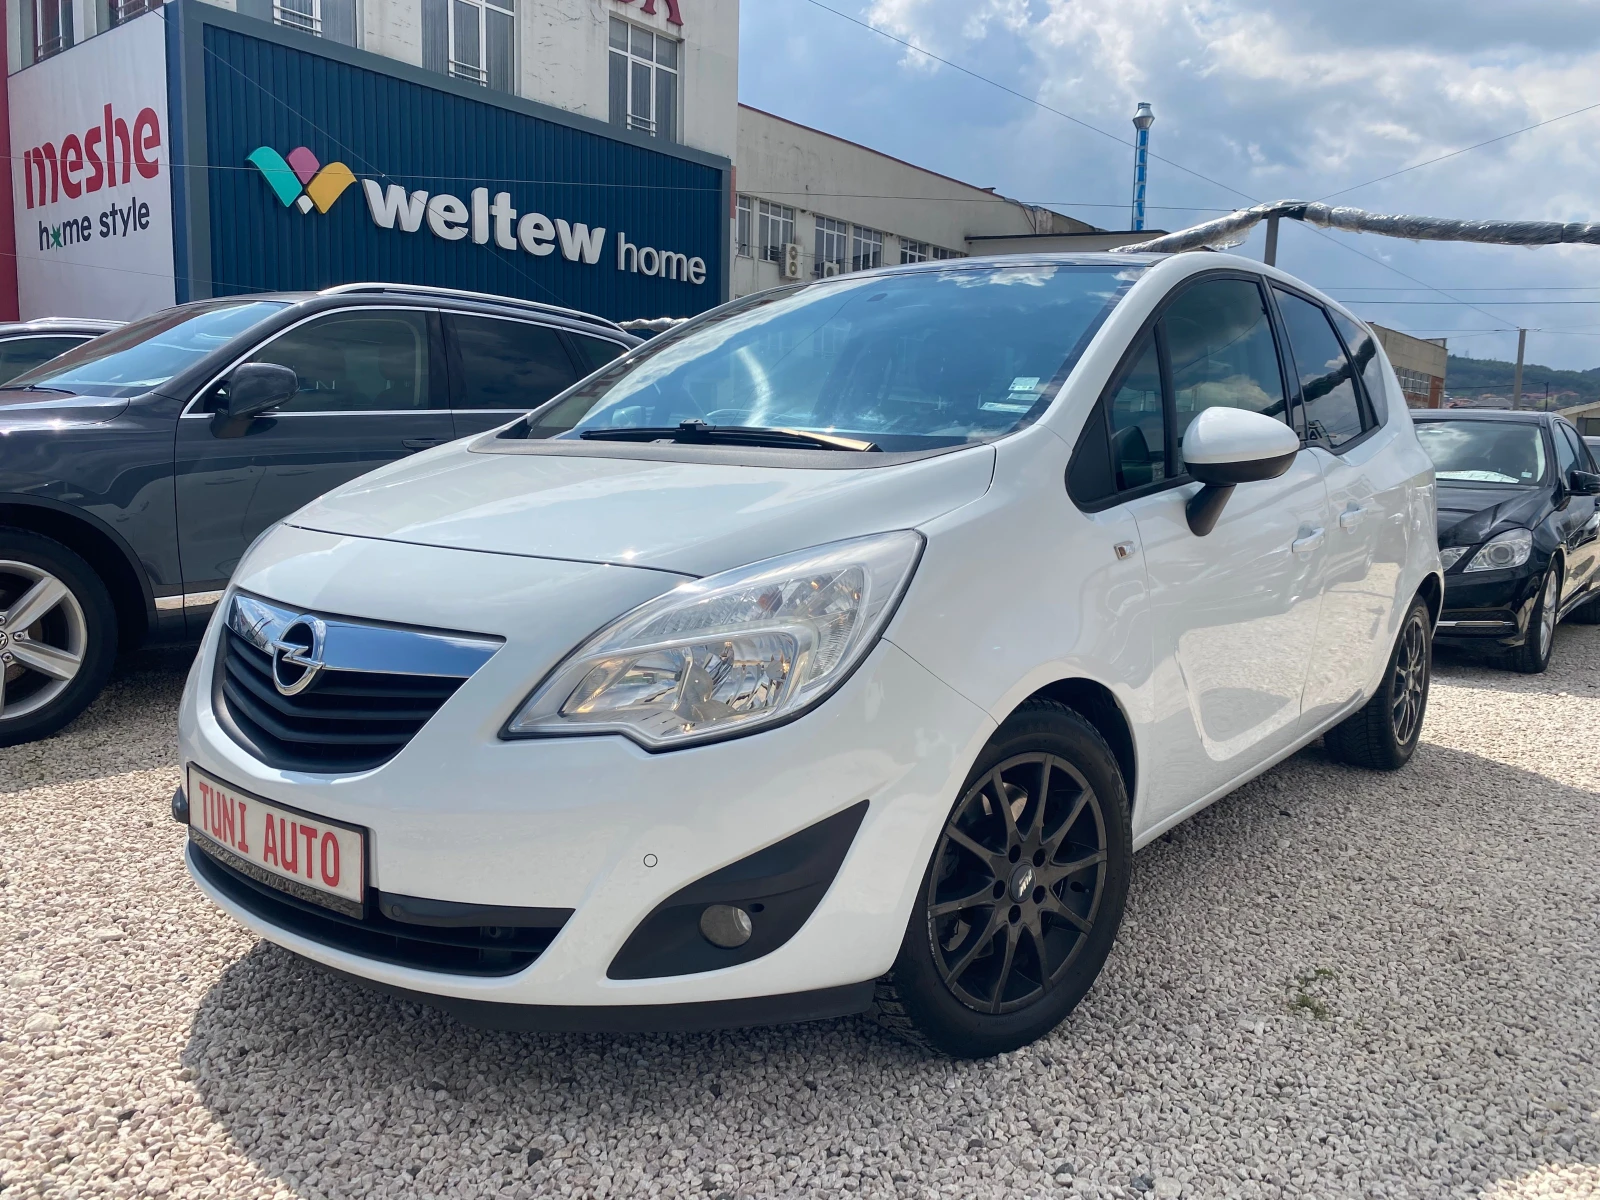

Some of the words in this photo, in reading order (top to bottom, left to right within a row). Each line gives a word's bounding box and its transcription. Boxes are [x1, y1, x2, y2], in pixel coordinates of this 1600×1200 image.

[24, 103, 161, 209] meshe
[99, 197, 150, 238] style
[361, 179, 606, 265] weltew
[617, 232, 707, 284] home
[199, 781, 249, 854] TUNI
[263, 813, 340, 888] AUTO
